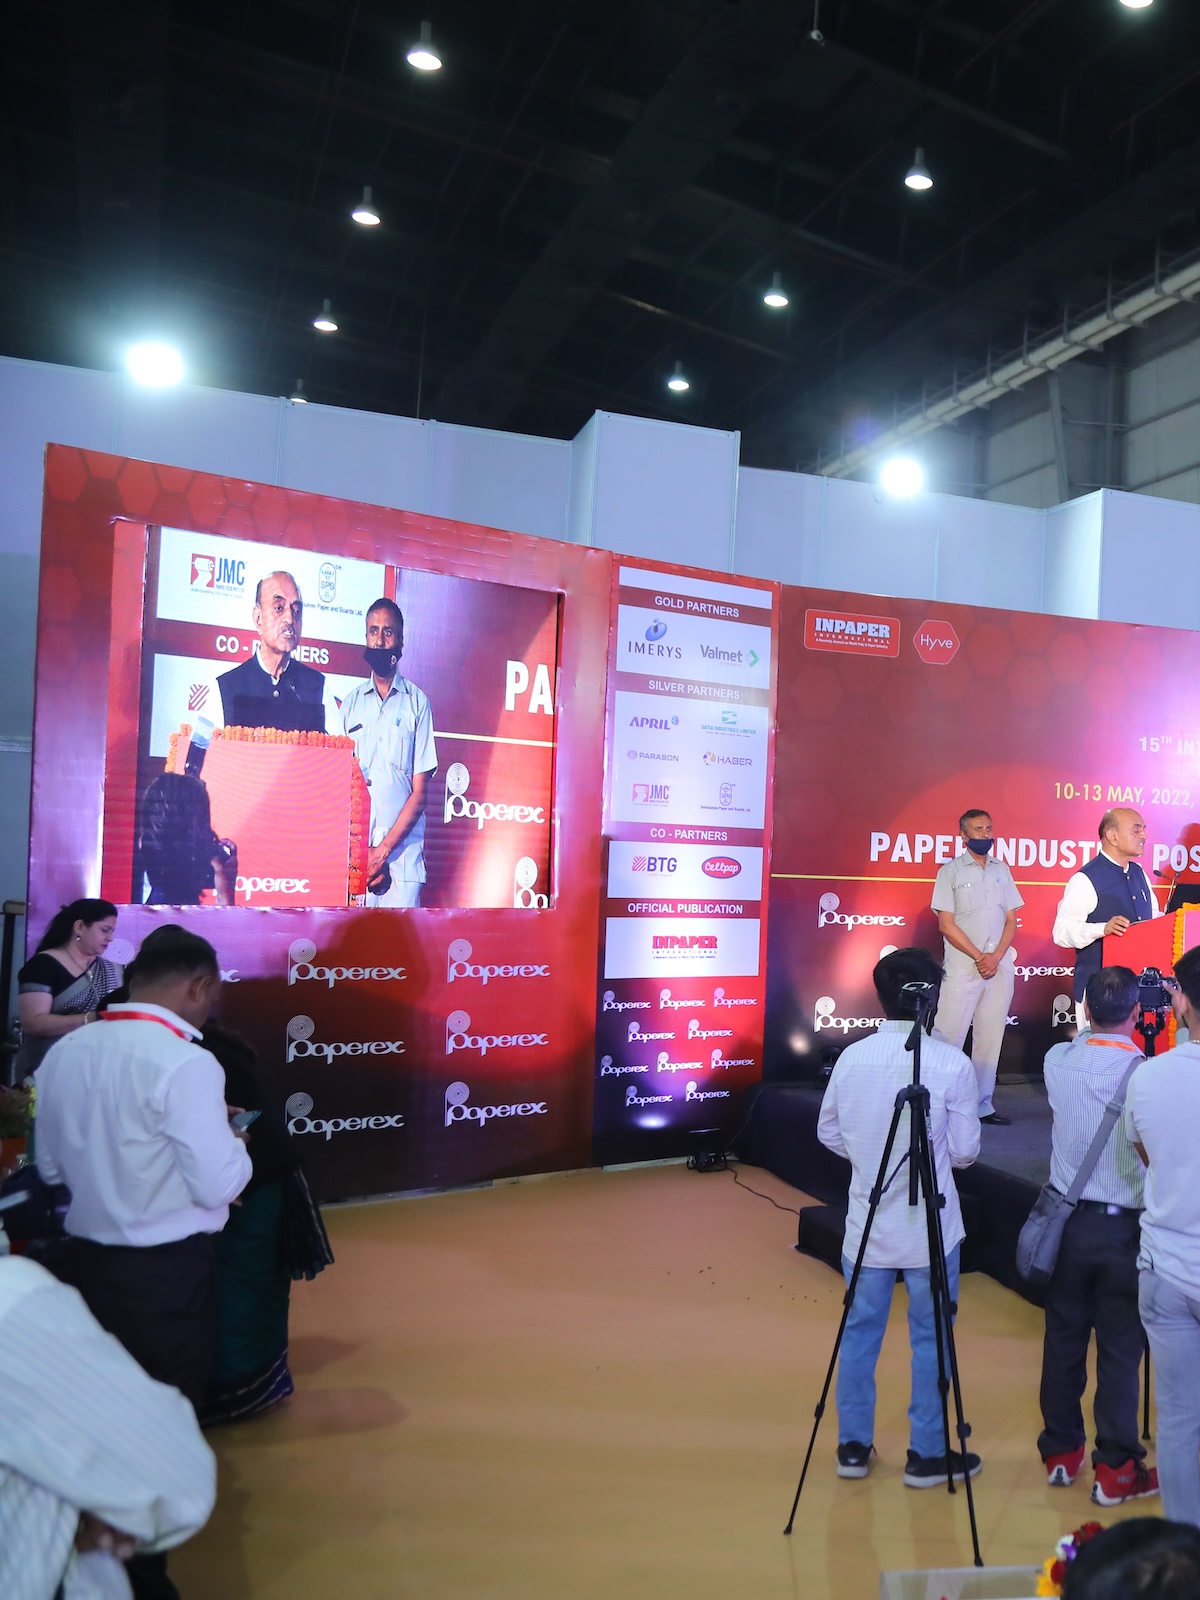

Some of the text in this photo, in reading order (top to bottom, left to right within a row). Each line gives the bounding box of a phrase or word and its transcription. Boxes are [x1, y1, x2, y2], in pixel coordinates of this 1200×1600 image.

[216, 558, 245, 586] JMC
[655, 595, 740, 618] GOLD PARTNERS
[814, 632, 890, 644] INTERNATIONAL
[815, 617, 890, 638] INPAPER
[216, 635, 240, 653] CO
[628, 641, 743, 663] IMERYS Valmet
[920, 634, 953, 650] Hyve
[648, 680, 740, 700] SILVER PARTNERS
[629, 716, 671, 730] APRIL
[639, 752, 679, 762] PARASON
[717, 755, 752, 767] HABER
[649, 784, 670, 800] JMC
[1054, 782, 1102, 801] 10-13
[1106, 786, 1146, 807] MAY,
[1151, 788, 1195, 809] 2022,
[445, 794, 545, 830] Paperex
[650, 828, 666, 838] CO
[674, 829, 728, 841] PARTNERS
[988, 838, 1101, 869] NDUST
[647, 856, 677, 873] BTG
[704, 861, 739, 874] Cellpap
[235, 876, 310, 901] aperex
[628, 903, 743, 914] OFFICIAL PUBLICATION
[819, 910, 906, 931] Paperex
[652, 935, 718, 949] INPAPER
[288, 962, 407, 988] Paperex
[447, 960, 550, 985] Paperex
[1014, 966, 1075, 982] aperex
[286, 1039, 406, 1065] Paperex
[446, 1031, 549, 1056] Paperex
[445, 1101, 549, 1127] Paperex
[288, 1113, 404, 1141] Paperex
